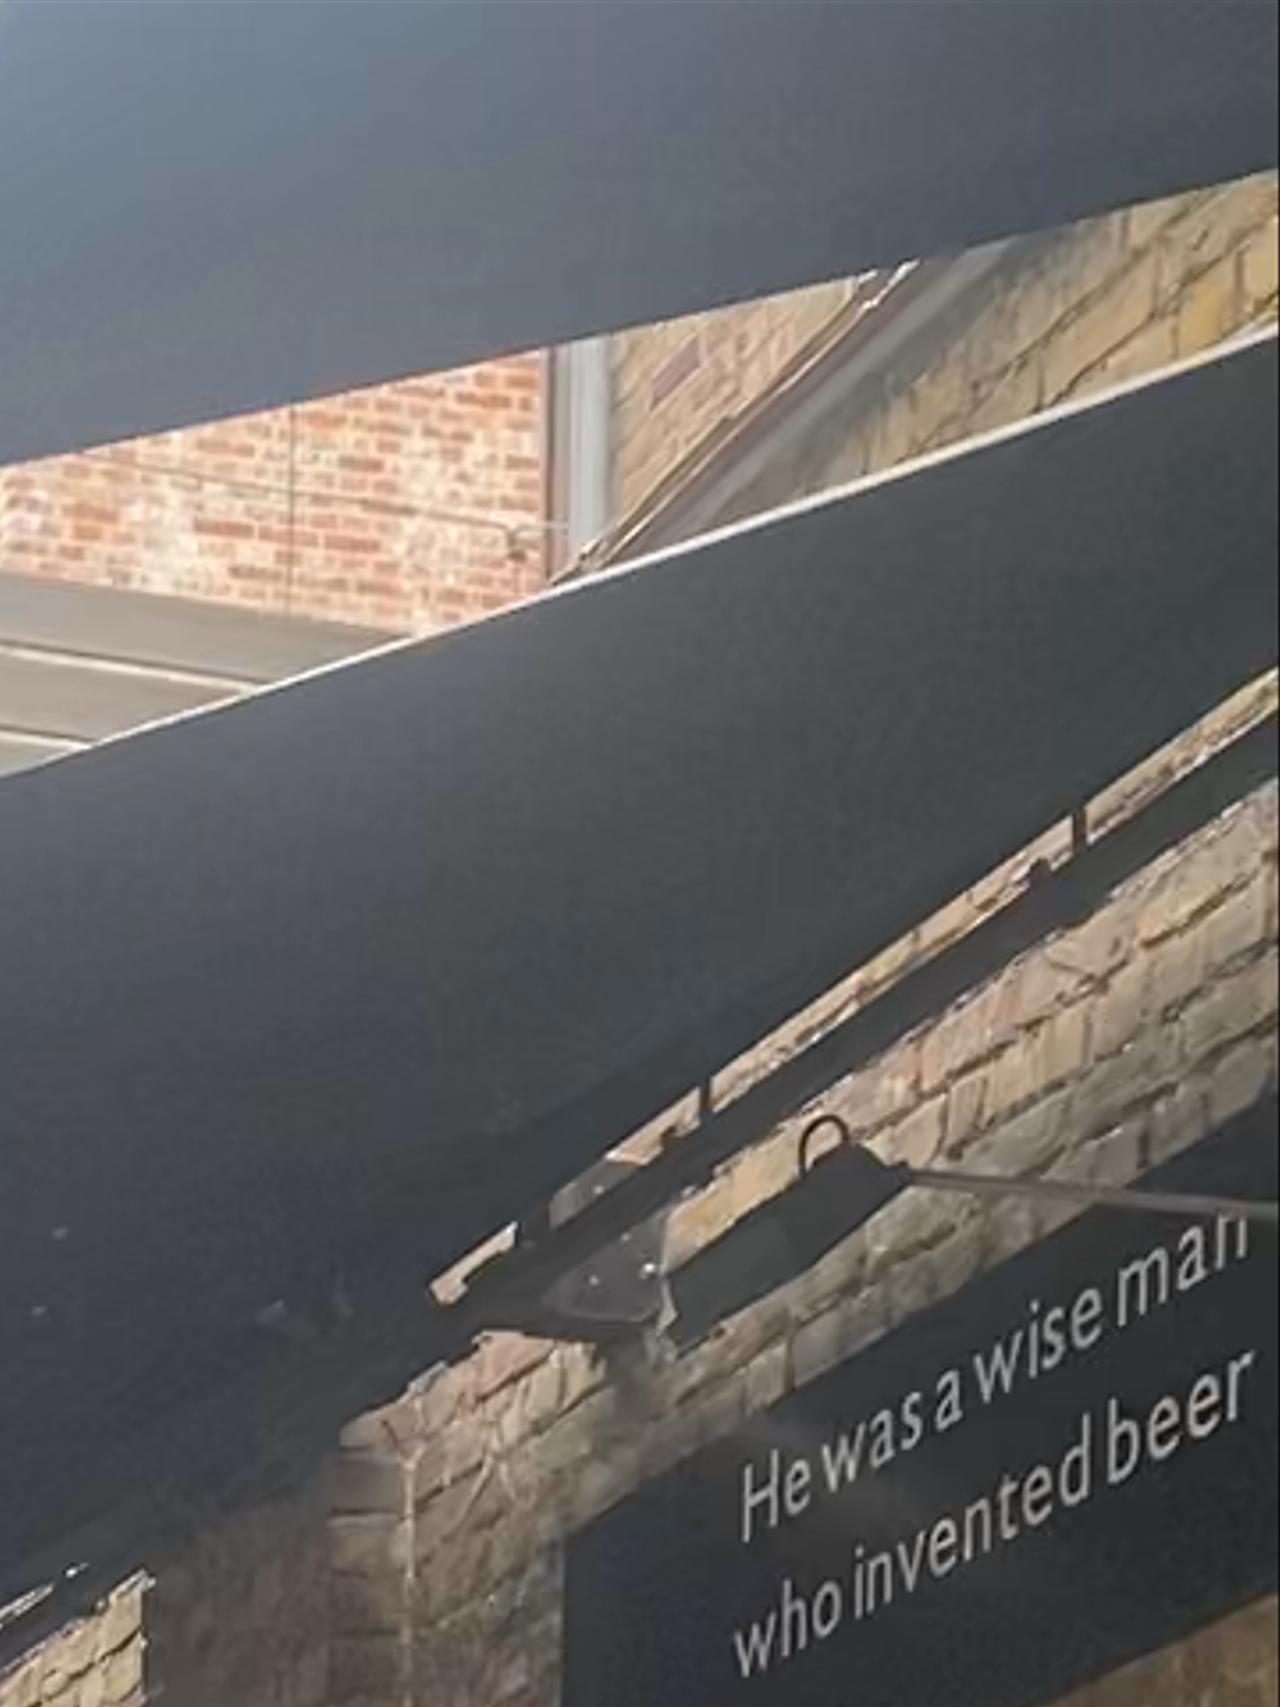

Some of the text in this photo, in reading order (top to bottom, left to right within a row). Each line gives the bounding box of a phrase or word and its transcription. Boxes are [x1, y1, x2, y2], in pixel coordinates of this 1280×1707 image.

[732, 1350, 1255, 1678] who invented beer
[740, 1212, 1248, 1543] He was a wise man
